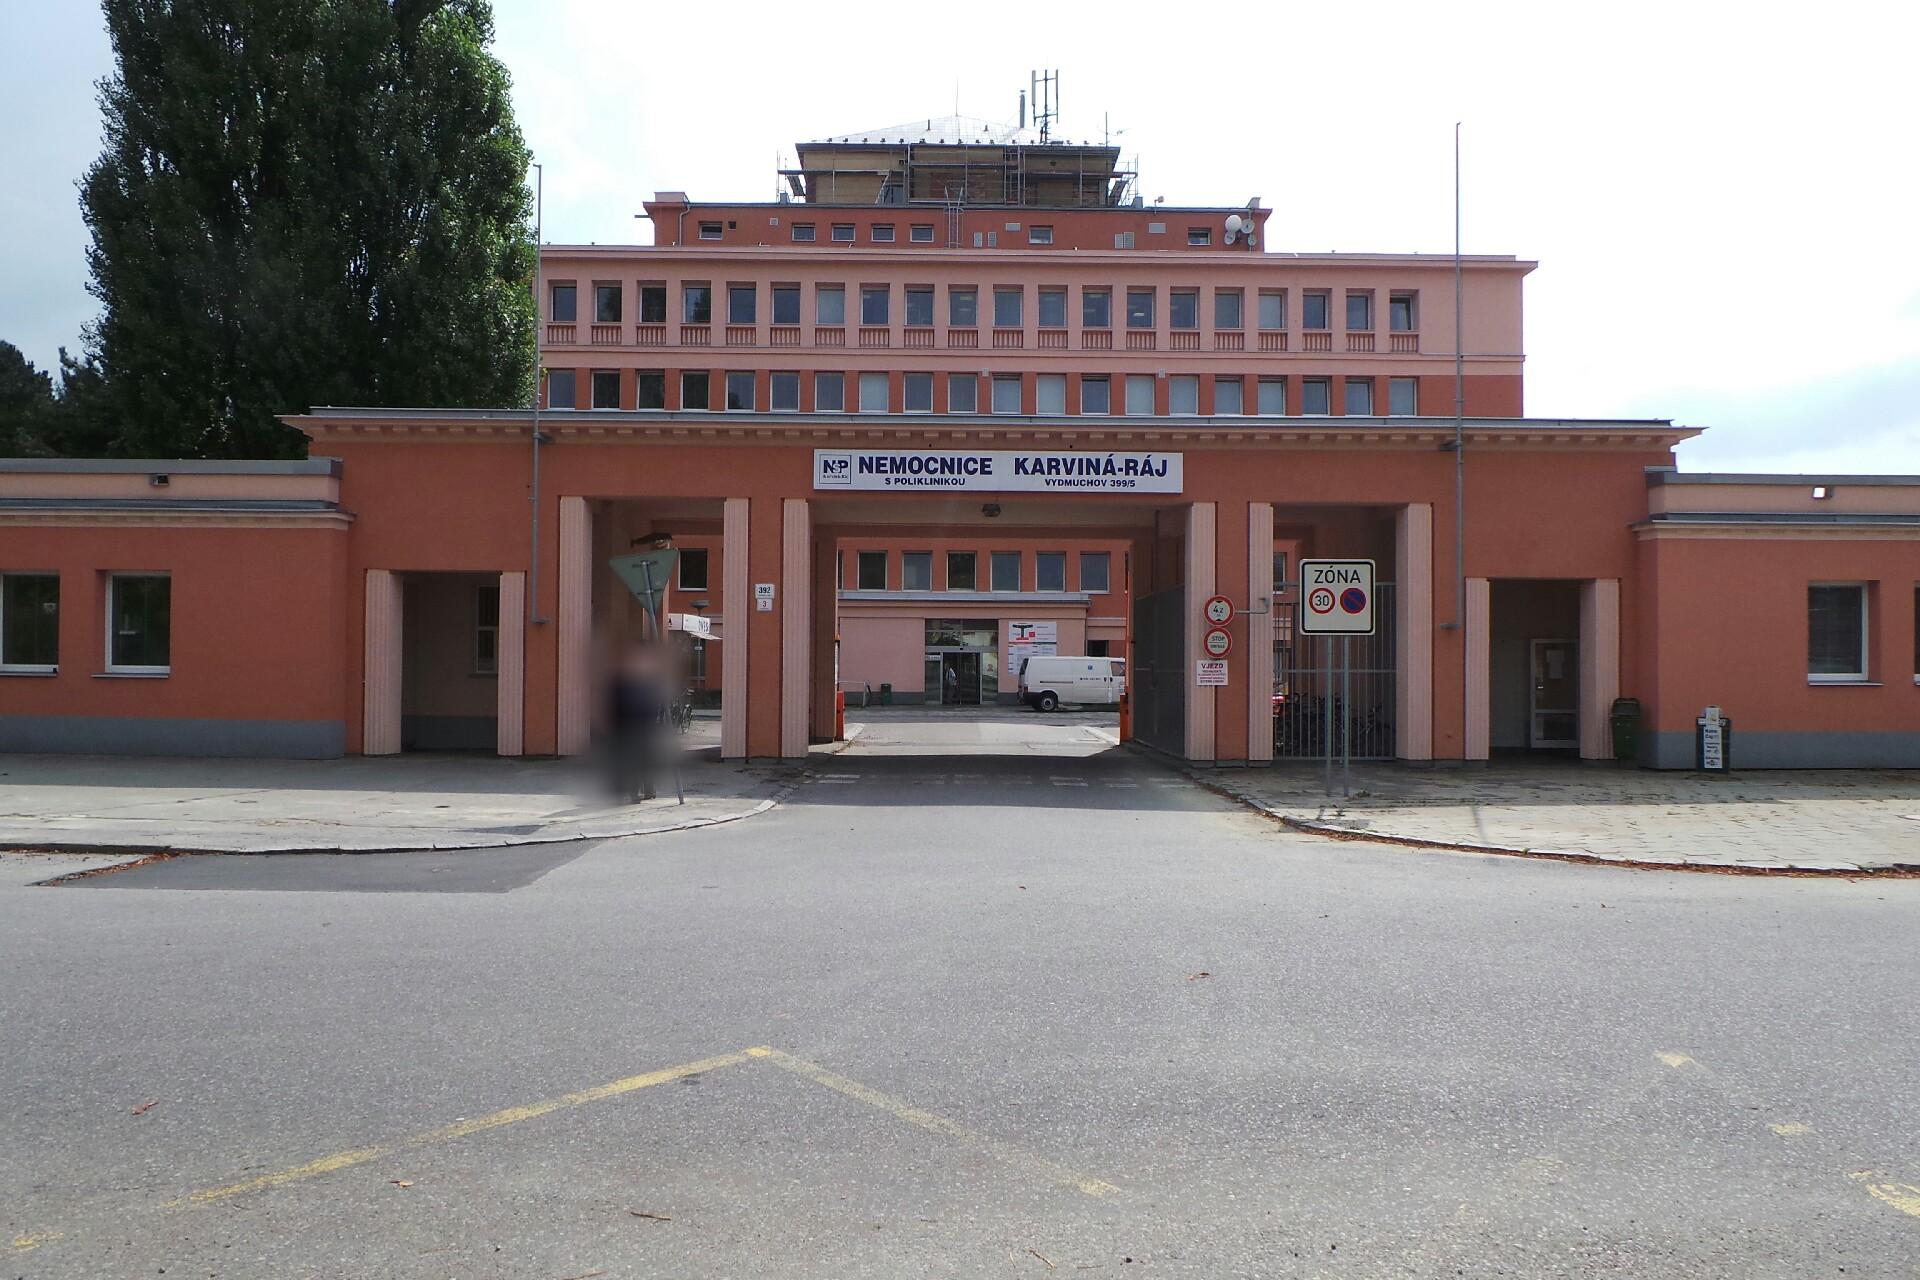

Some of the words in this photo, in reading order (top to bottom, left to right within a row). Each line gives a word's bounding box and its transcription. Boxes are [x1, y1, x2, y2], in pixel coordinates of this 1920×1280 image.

[859, 456, 993, 475] NEMOCNICE
[1014, 453, 1168, 477] KARVINÁ-RÁJ
[885, 477, 891, 486] S
[894, 477, 966, 486] POLIKLINIKOU
[1045, 479, 1107, 487] VYDMUCHOV
[1110, 479, 1136, 488] 399/5
[1314, 565, 1361, 584] ZÓNA
[762, 600, 767, 608] 3
[1314, 595, 1330, 607] 30
